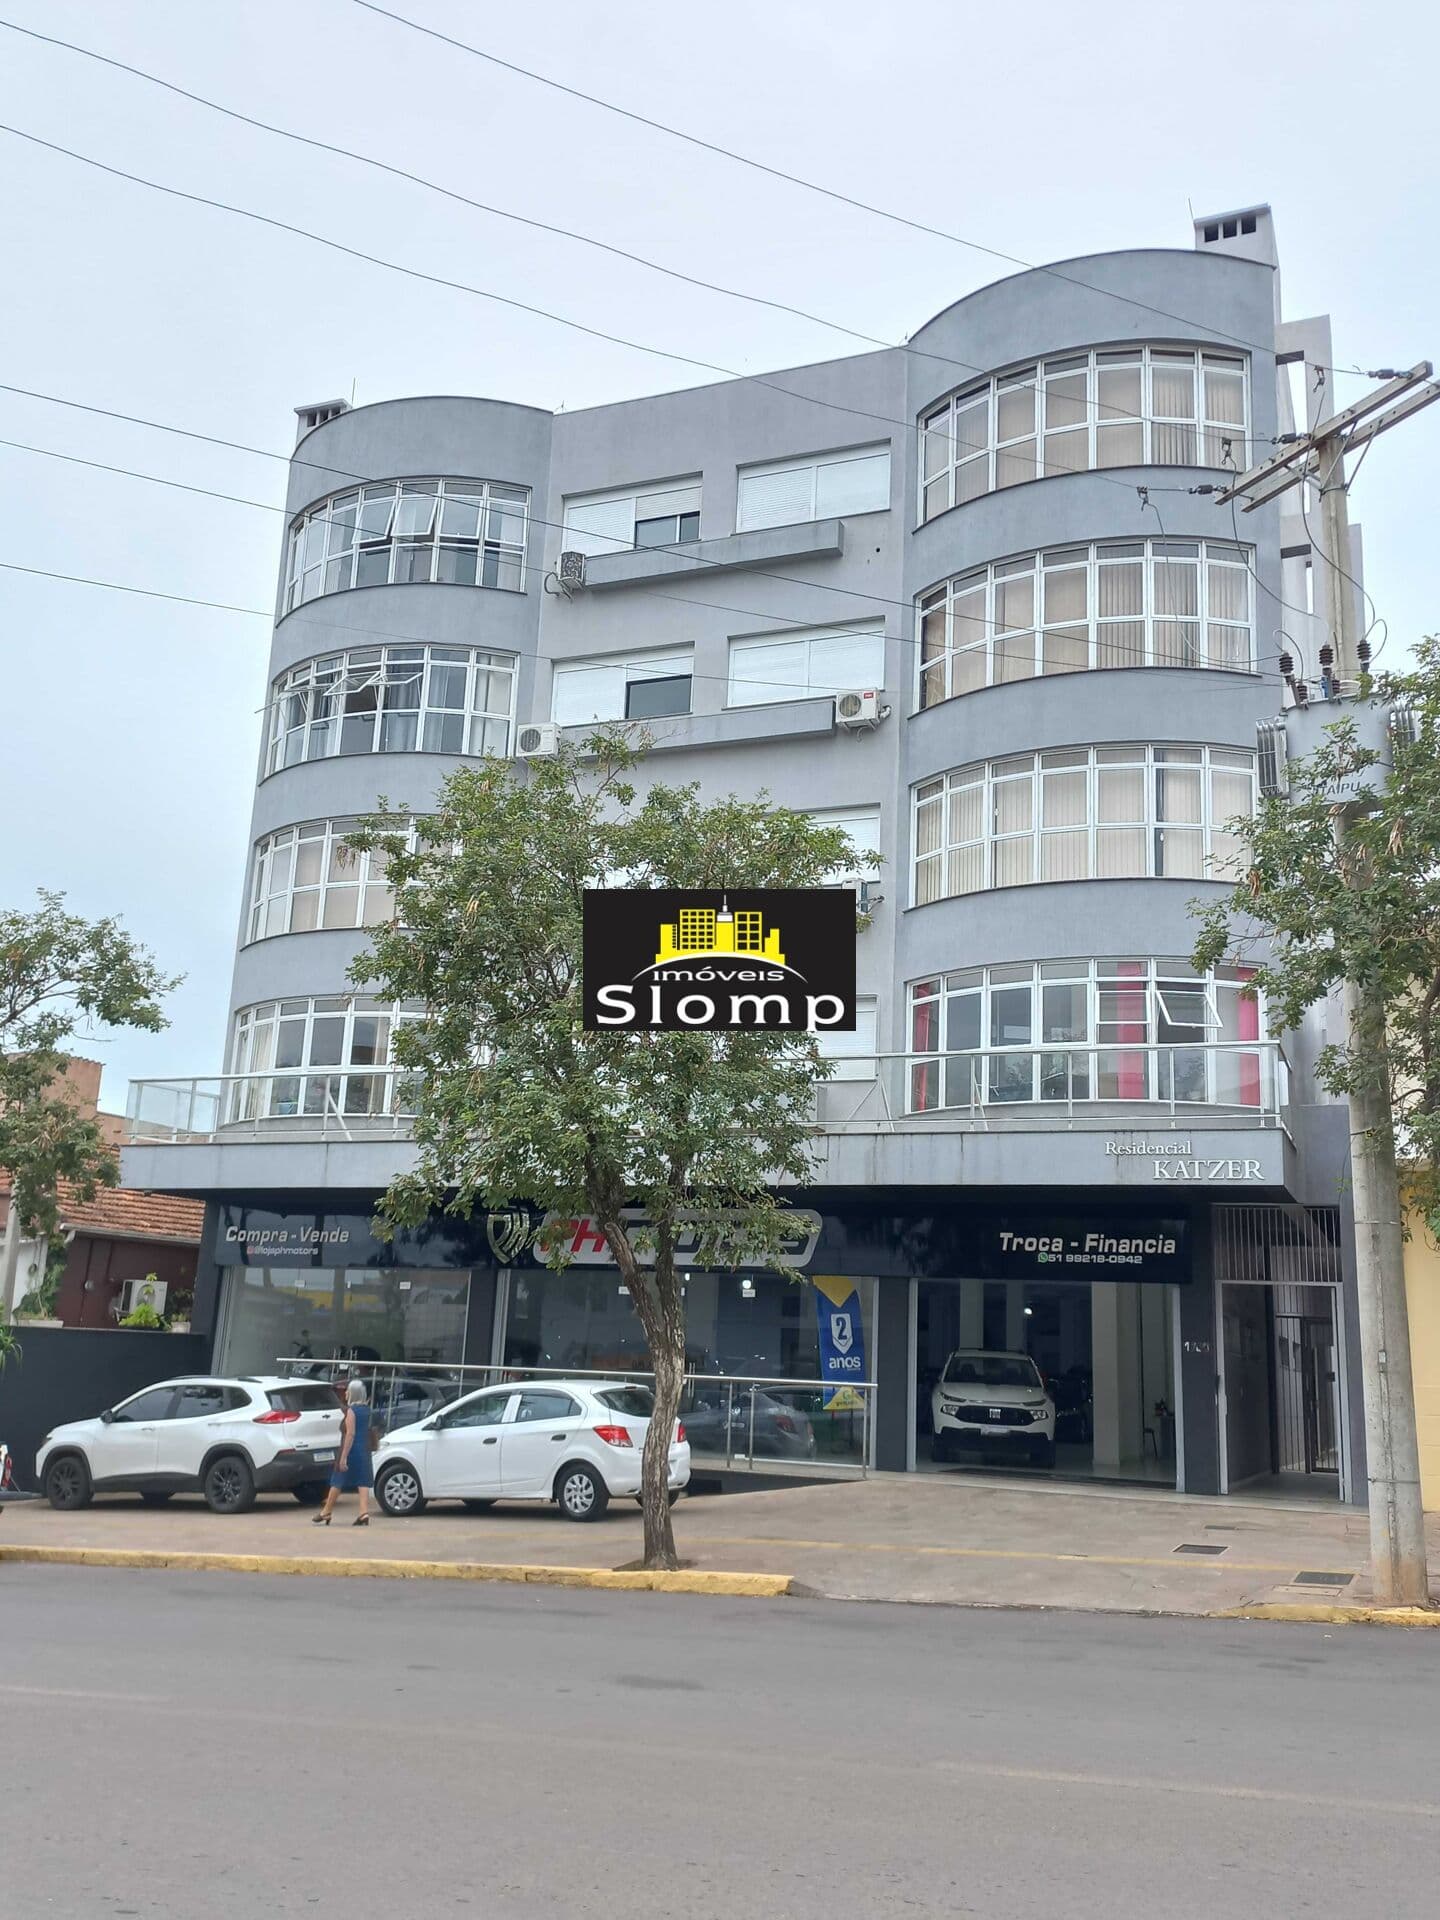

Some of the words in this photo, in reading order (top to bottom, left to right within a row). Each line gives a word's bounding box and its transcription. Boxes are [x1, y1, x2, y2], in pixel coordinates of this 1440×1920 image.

[1105, 1141, 1192, 1155] Residencial
[1153, 1160, 1265, 1180] KATZER
[226, 1226, 288, 1245] Compra
[299, 1227, 349, 1243] Vende
[1000, 1233, 1063, 1251] Troca
[1085, 1234, 1176, 1254] Financia
[1048, 1254, 1062, 1262] 51
[836, 1317, 847, 1340] 2
[829, 1356, 861, 1369] anos
